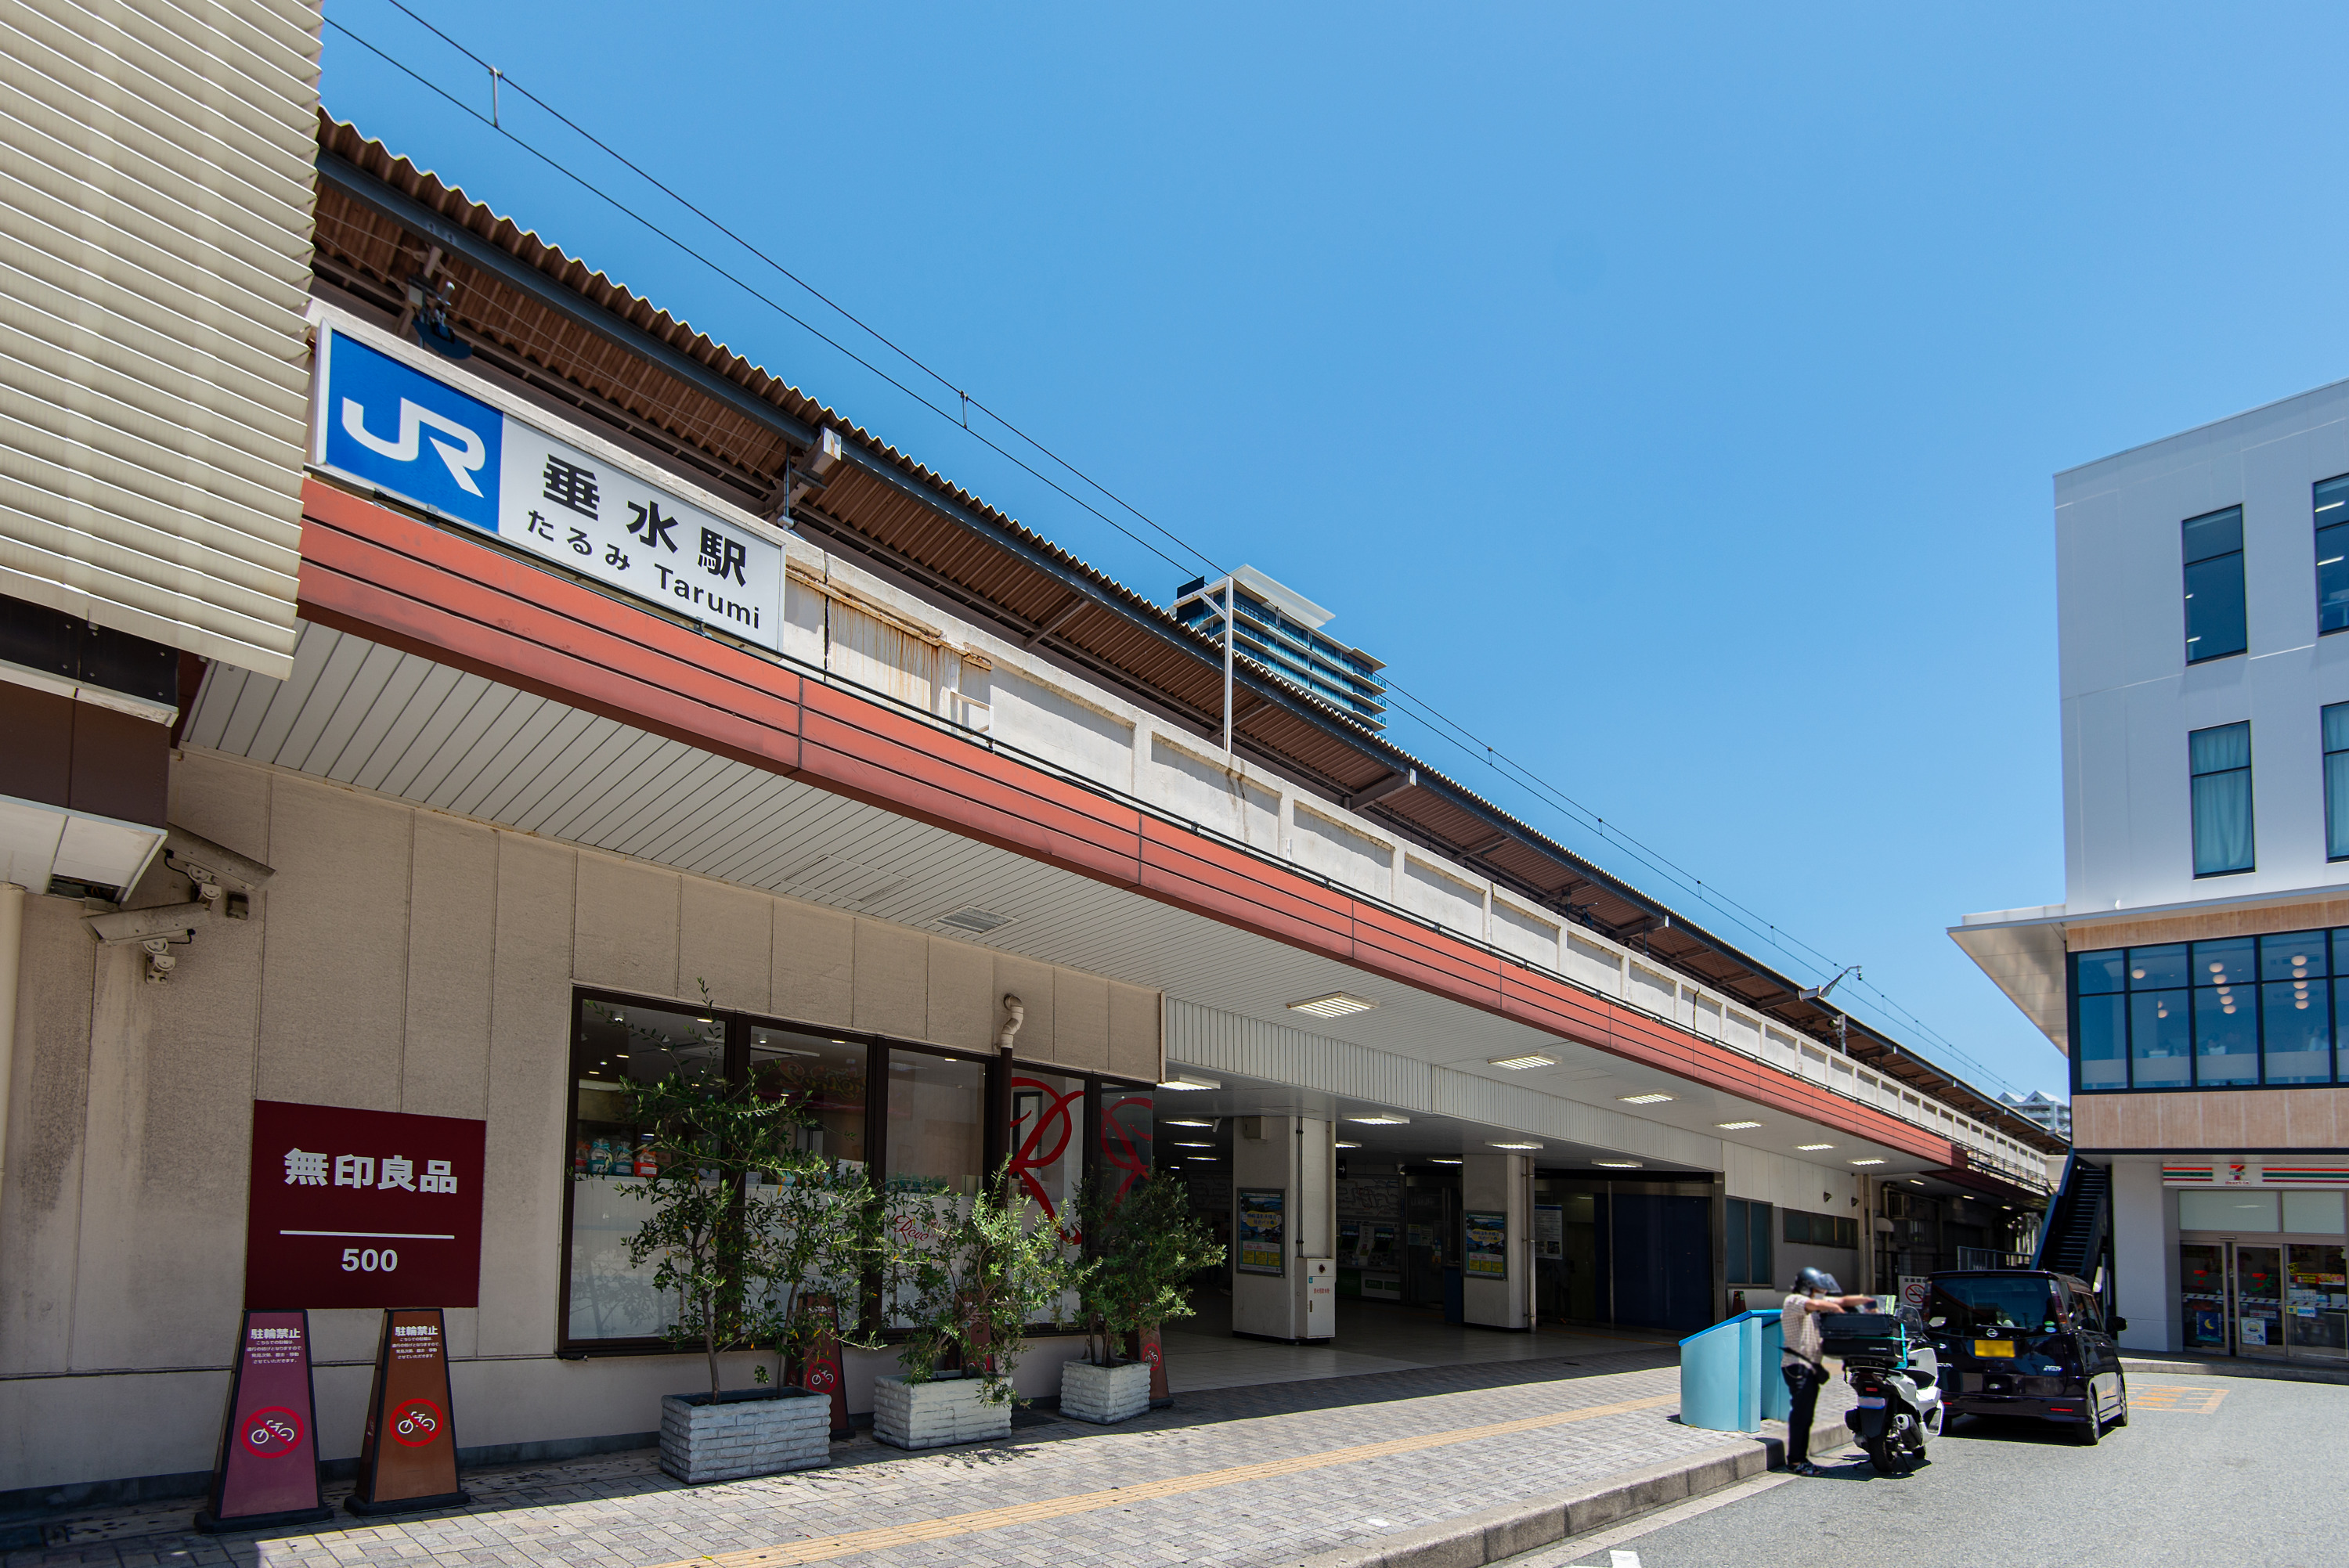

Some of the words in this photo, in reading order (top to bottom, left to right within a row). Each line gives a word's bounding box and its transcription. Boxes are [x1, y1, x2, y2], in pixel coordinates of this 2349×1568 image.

[342, 397, 485, 498] JR
[543, 454, 747, 587] 垂水駅
[528, 510, 630, 571] たるみ
[654, 564, 760, 629] Tarumi
[284, 1148, 457, 1194] 無印良品
[341, 1249, 398, 1272] 500
[251, 1328, 301, 1339] 駐輪禁止
[395, 1325, 438, 1336] 駐輪禁止
